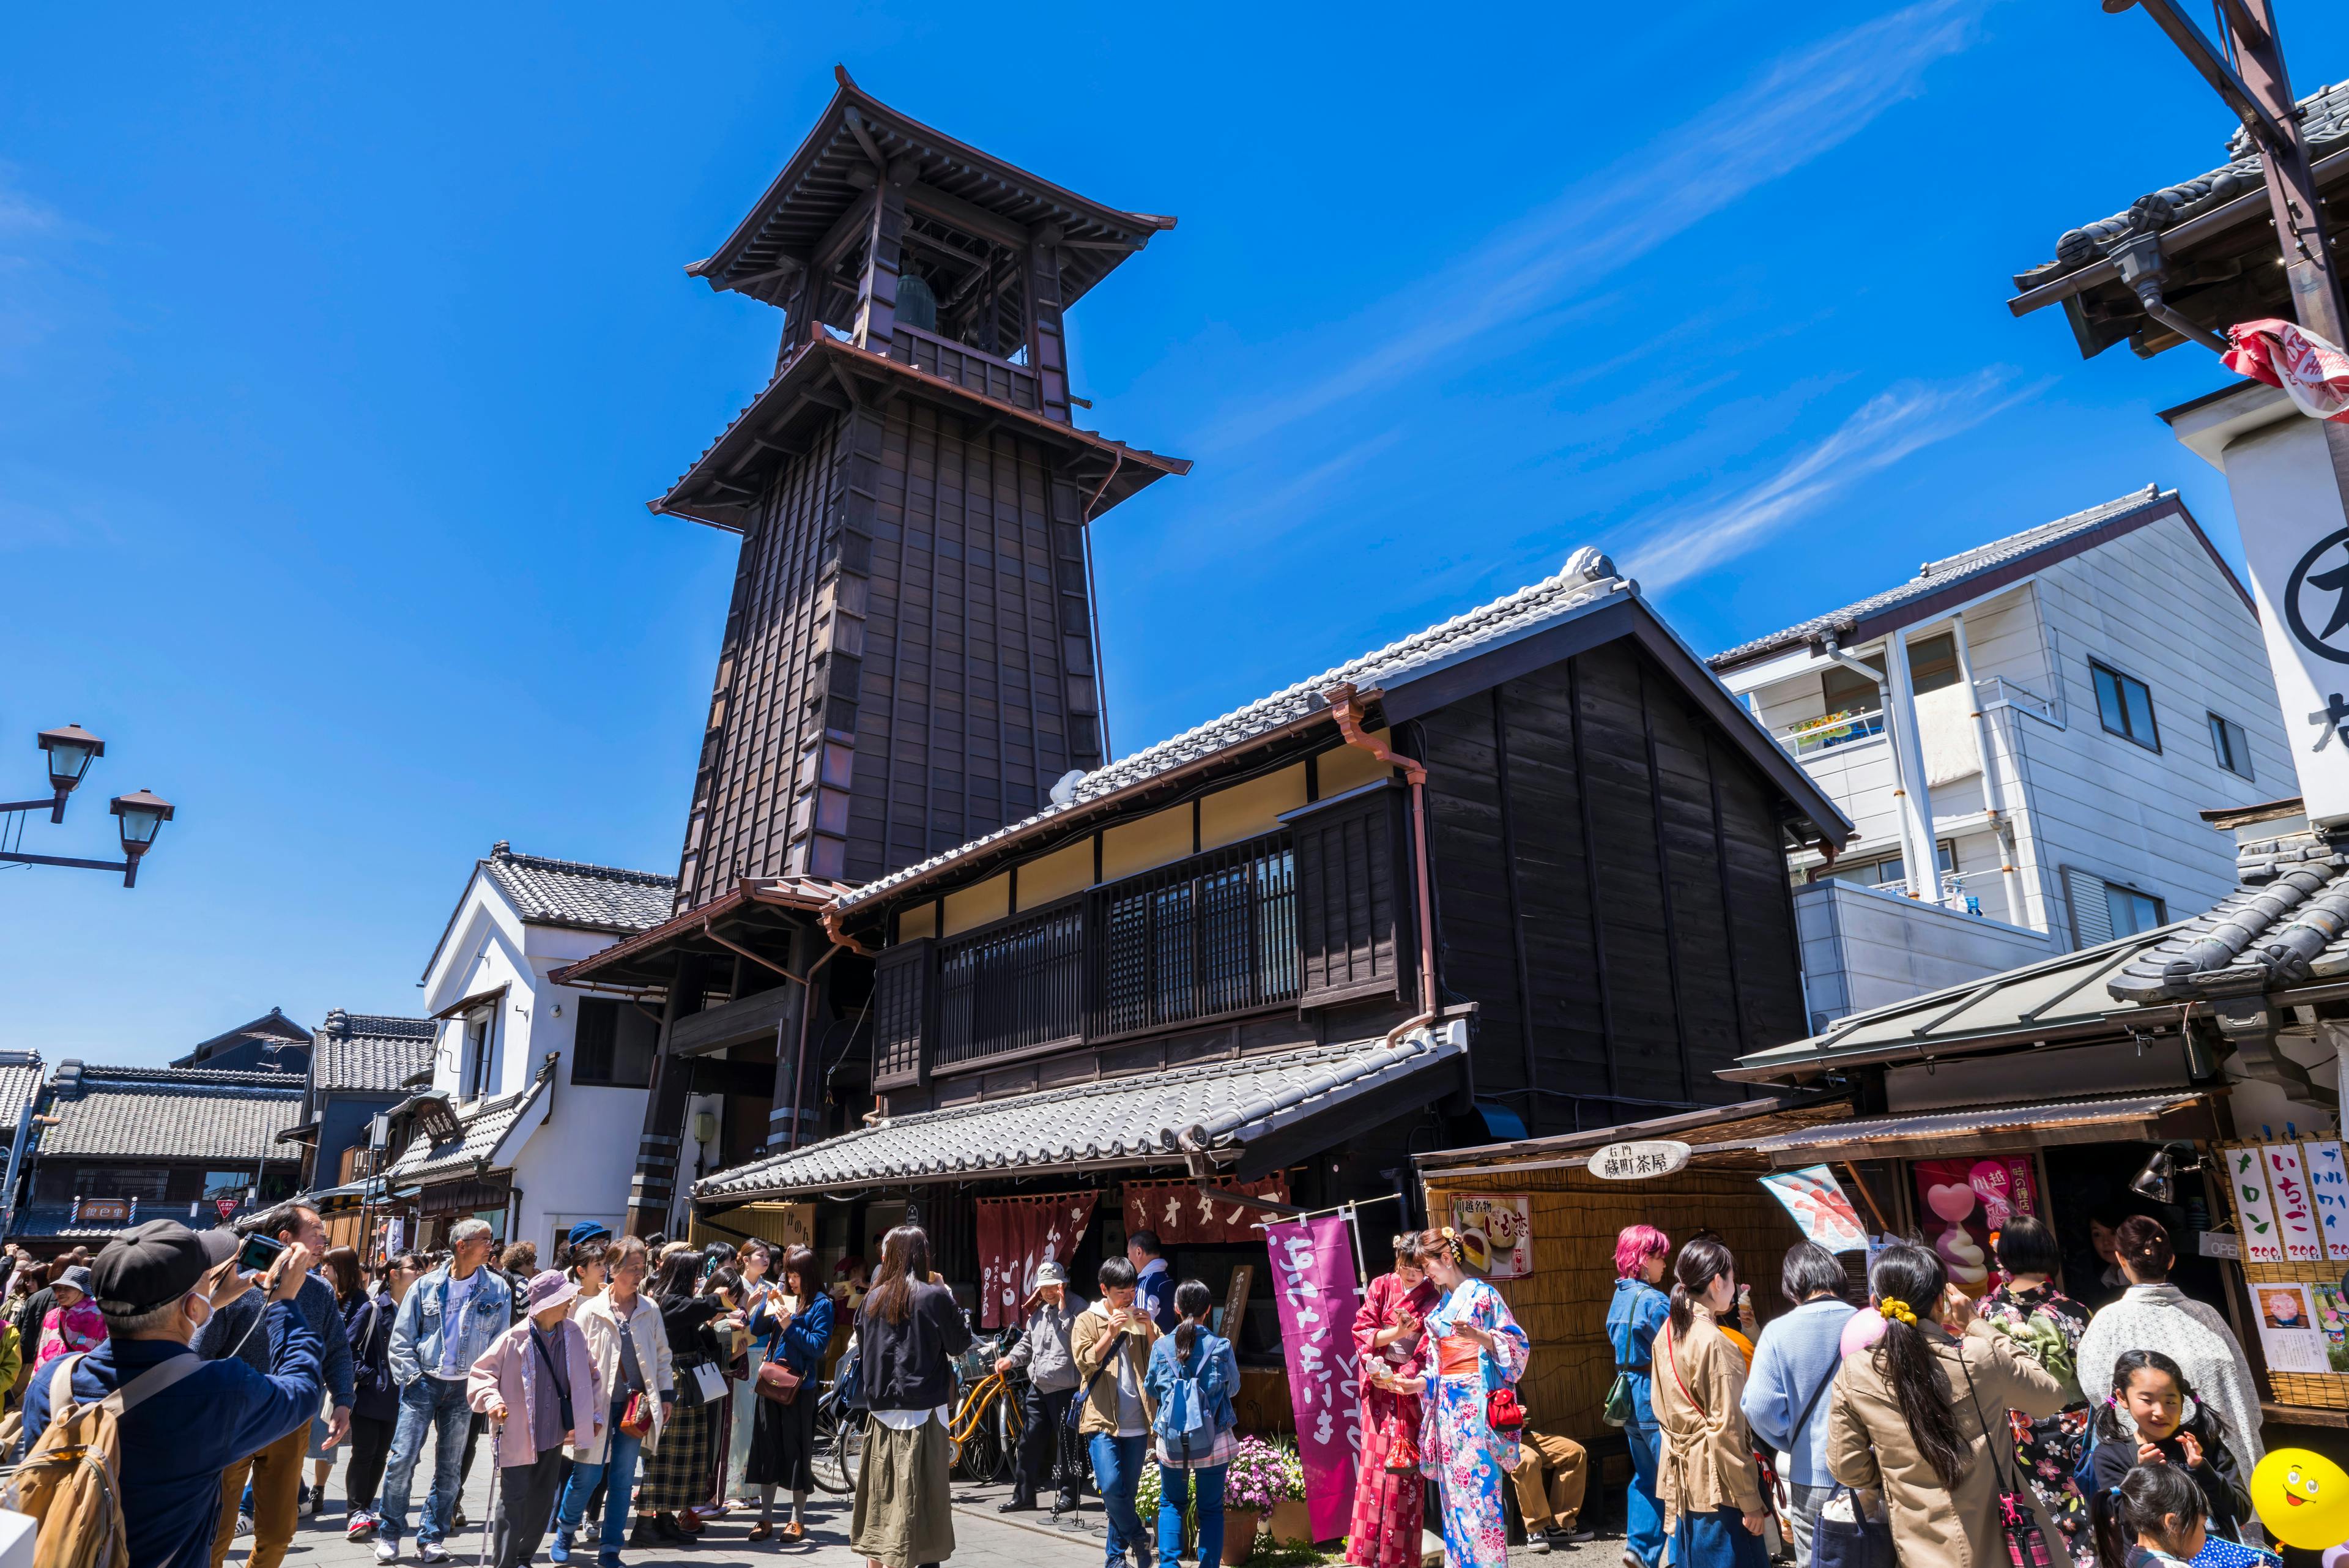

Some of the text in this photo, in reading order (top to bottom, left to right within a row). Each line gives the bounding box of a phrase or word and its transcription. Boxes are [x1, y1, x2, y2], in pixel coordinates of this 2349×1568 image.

[1609, 1145, 1632, 1157] 右門
[1604, 1153, 1668, 1178] 蔵町茶屋
[2236, 1153, 2270, 1235] メロン
[2271, 1153, 2309, 1232] いちご
[1456, 1200, 1491, 1213] 川越名物
[787, 1211, 809, 1241] かのん
[1484, 1211, 1529, 1239] いも恋
[2211, 1242, 2238, 1256] OPE
[2250, 1246, 2279, 1257] 200
[2288, 1244, 2318, 1256] 200
